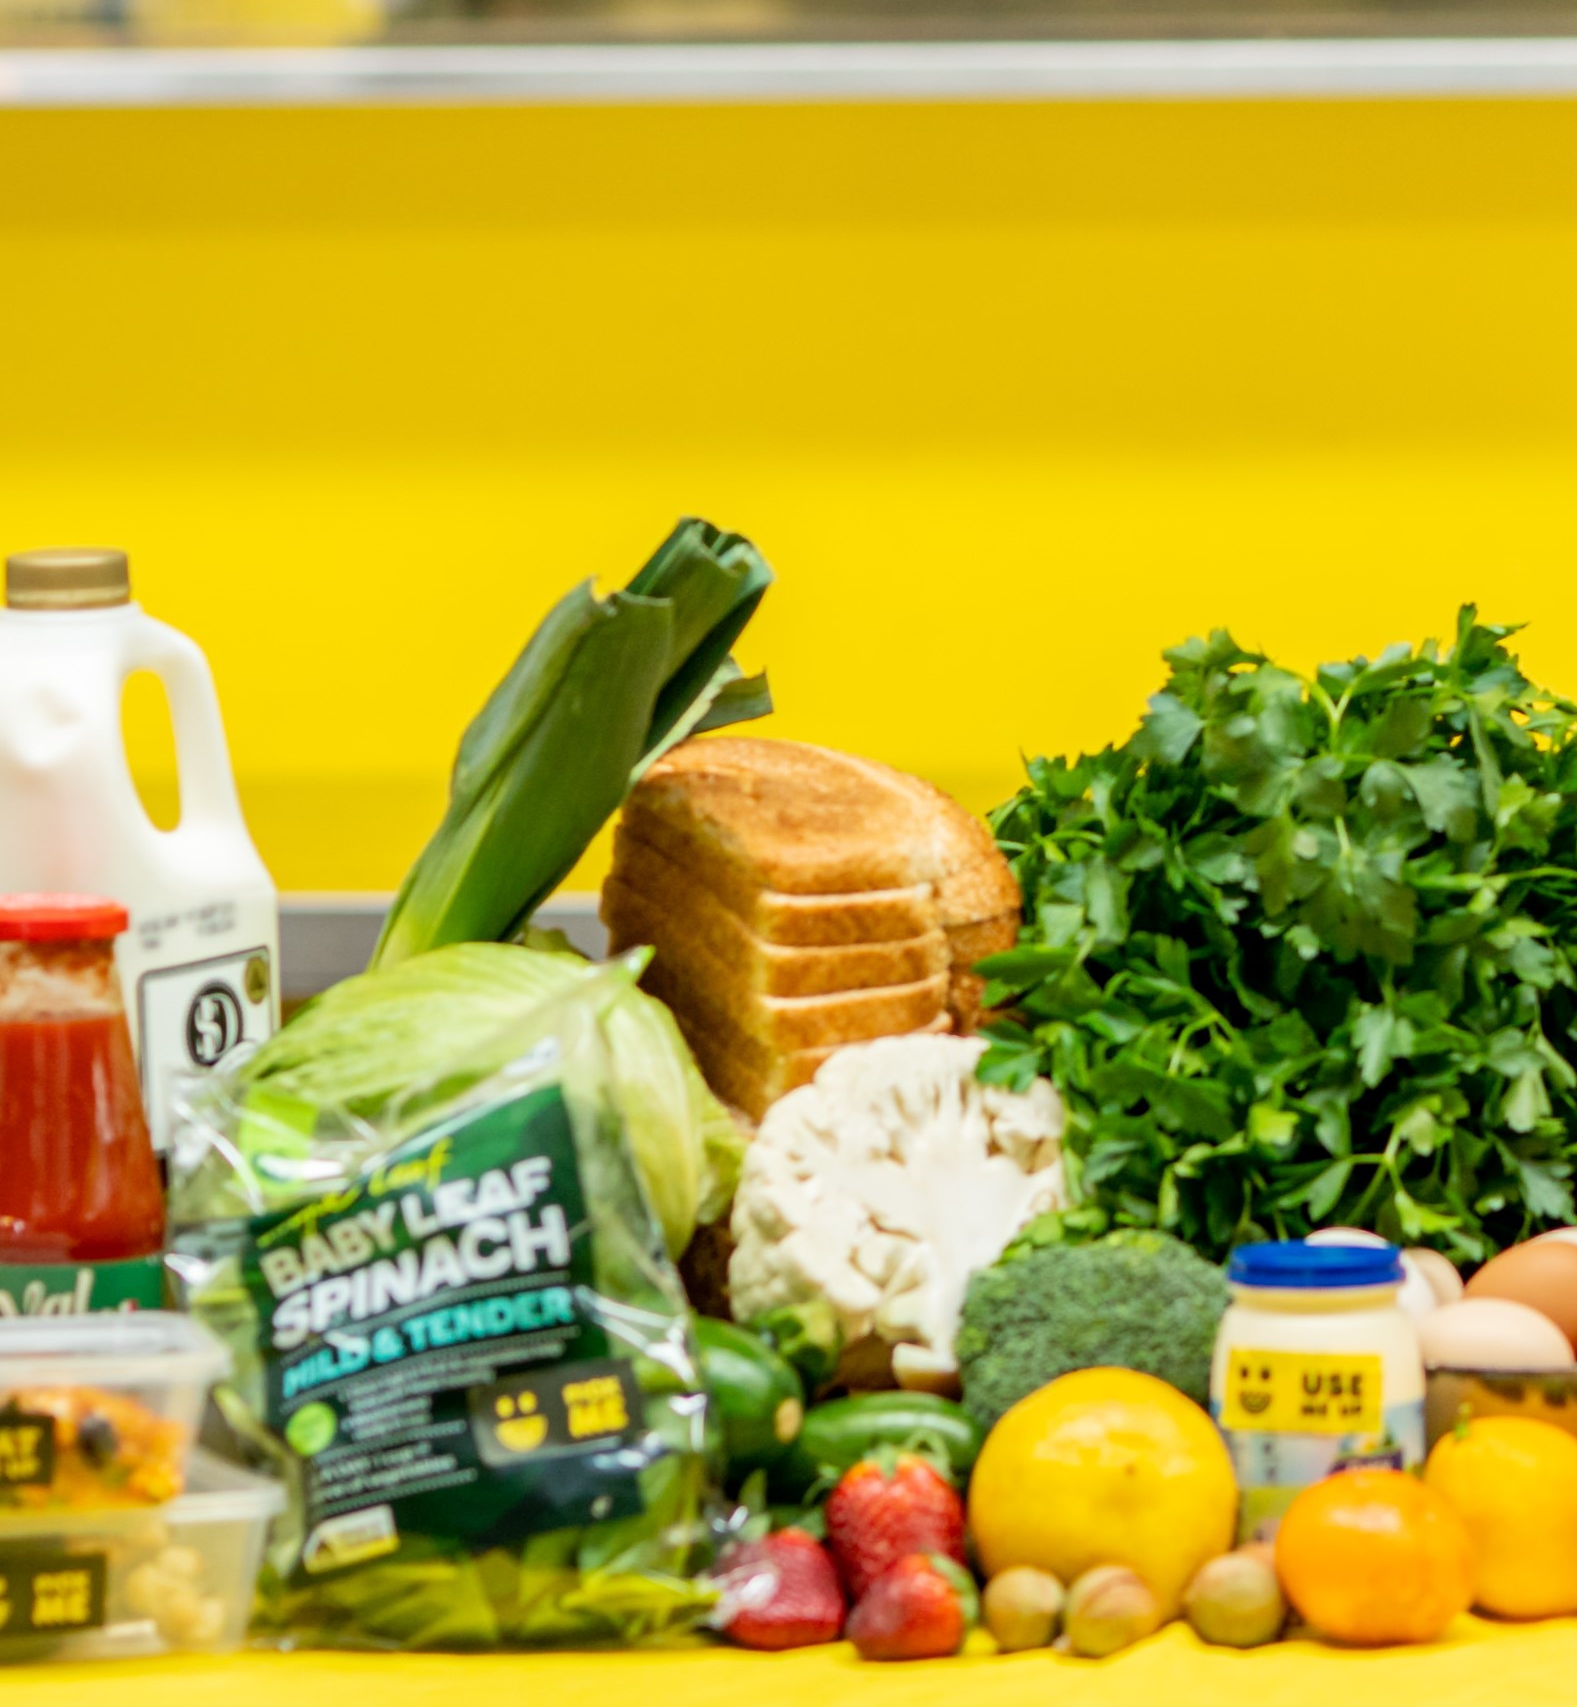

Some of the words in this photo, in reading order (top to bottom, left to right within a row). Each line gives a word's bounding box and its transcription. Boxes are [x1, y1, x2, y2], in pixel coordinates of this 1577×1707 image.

[259, 1201, 398, 1299] BABY
[400, 1154, 553, 1240] LEAF
[272, 1203, 571, 1350] SPINACH
[283, 1333, 373, 1398] MILD
[371, 1325, 404, 1364] &
[402, 1285, 575, 1352] TENDER
[1302, 1372, 1364, 1397] USE
